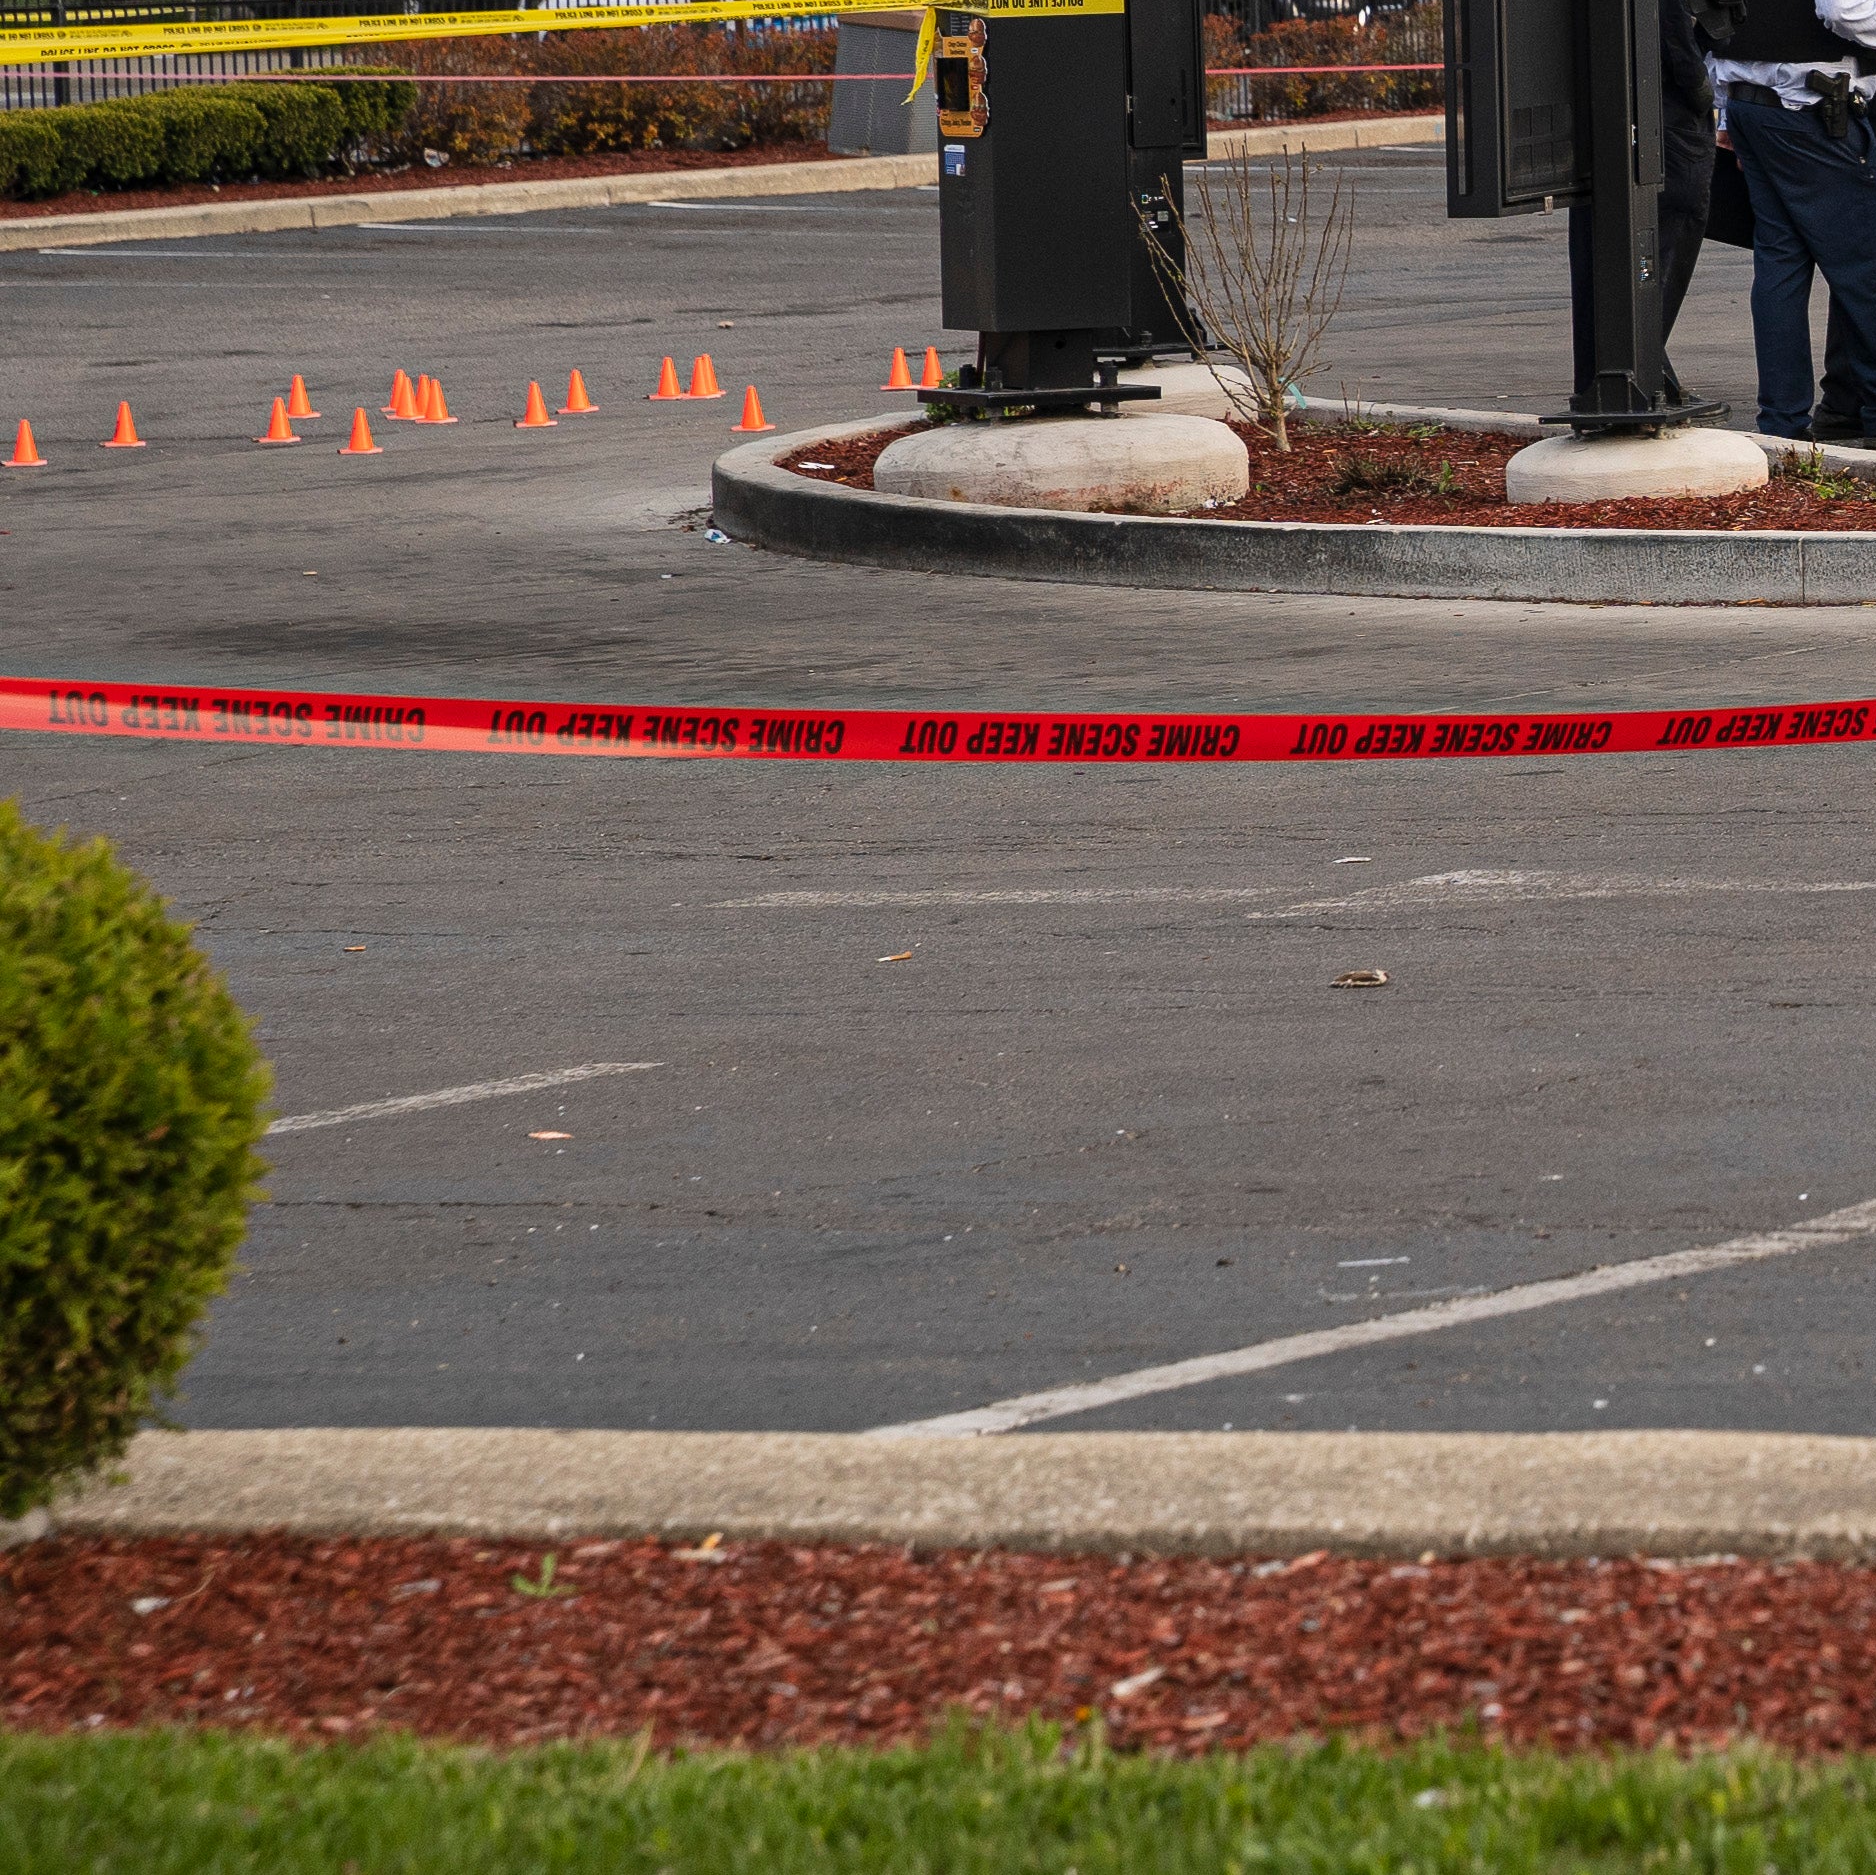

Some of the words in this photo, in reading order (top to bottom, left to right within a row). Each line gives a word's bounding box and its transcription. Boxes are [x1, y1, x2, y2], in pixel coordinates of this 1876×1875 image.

[47, 689, 109, 727] OUT
[119, 694, 201, 732] KEEP
[211, 698, 313, 738] SCENE
[323, 703, 425, 743] CRIME
[1784, 706, 1869, 739] SCENE
[486, 709, 547, 746] OUT
[555, 712, 634, 748] KEEP
[642, 715, 740, 753] SCENE
[747, 718, 845, 754] CRIME
[898, 719, 958, 754] OUT
[965, 721, 1040, 755] KEEP
[1046, 722, 1141, 757] SCENE
[1145, 723, 1240, 757] CRIME
[1289, 722, 1348, 755] OUT
[1353, 723, 1426, 754] KEEP
[1428, 722, 1520, 753] SCENE
[1521, 720, 1612, 750] CRIME
[1655, 715, 1713, 745] OUT
[1717, 711, 1783, 742] KEEP
